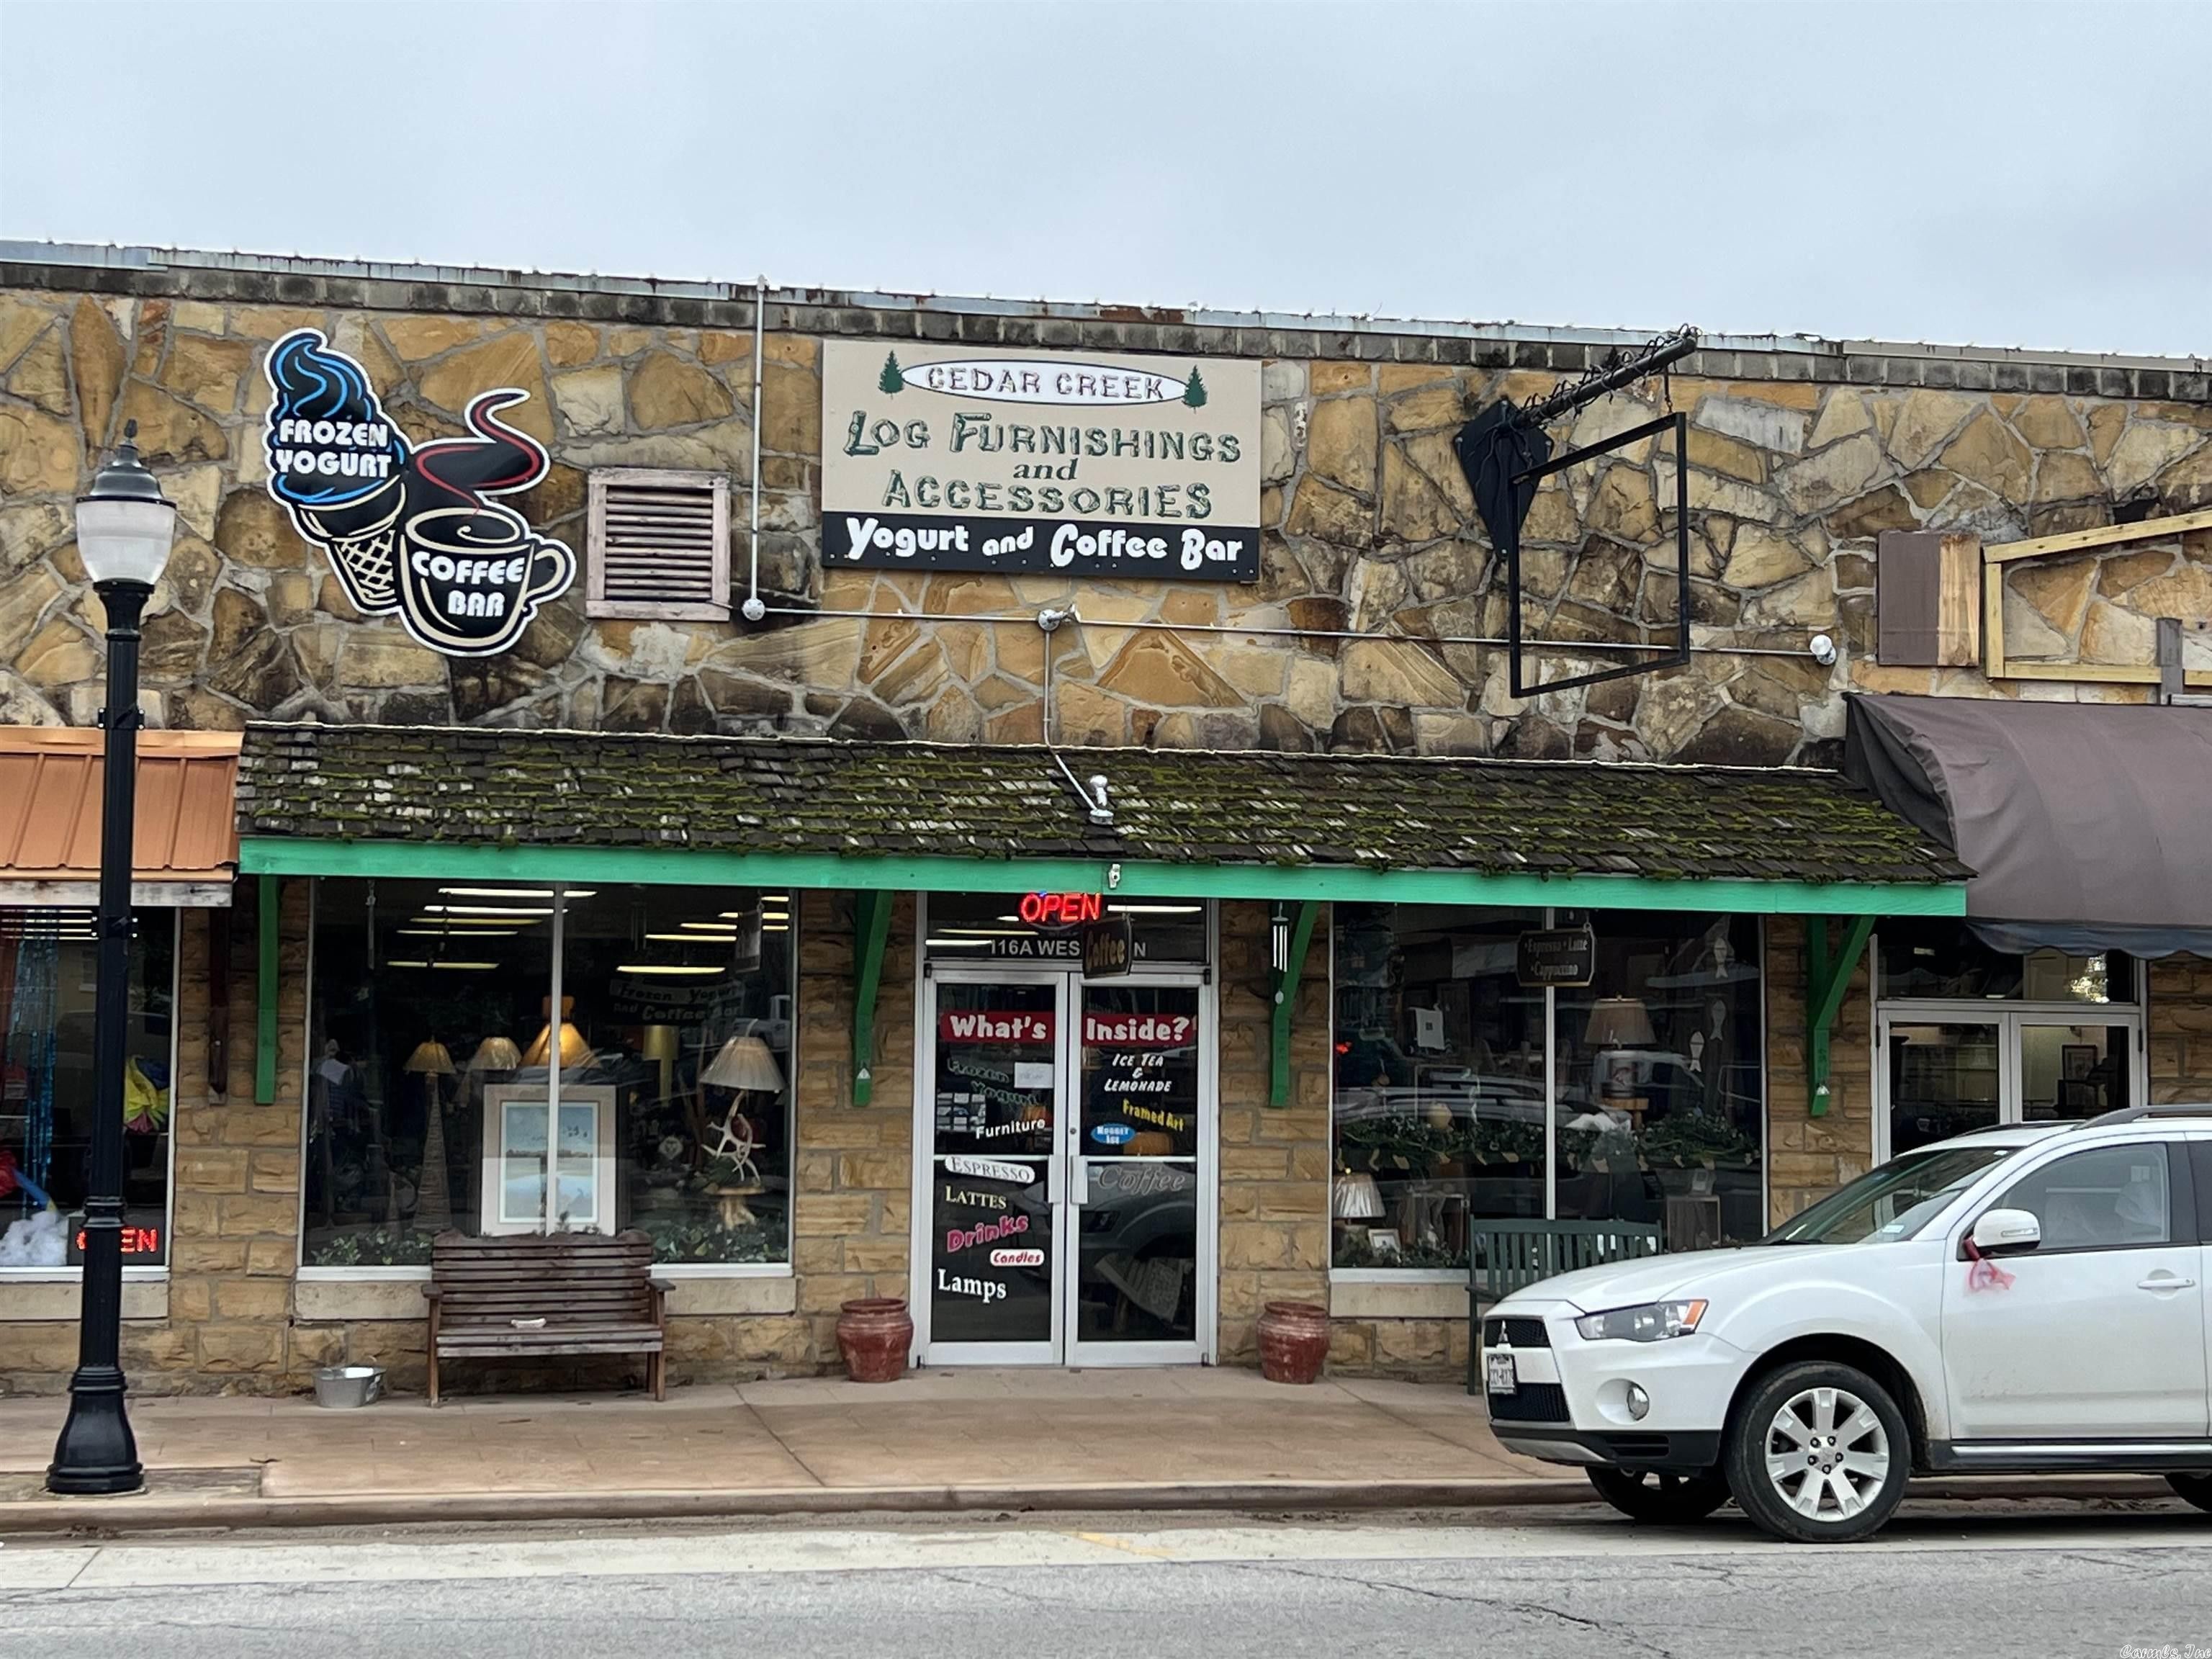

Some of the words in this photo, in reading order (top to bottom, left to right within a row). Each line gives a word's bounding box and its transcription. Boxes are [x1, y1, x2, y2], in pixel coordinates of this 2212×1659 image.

[927, 366, 1041, 395] CEDAR
[1056, 372, 1165, 402] CREEK
[278, 418, 389, 449] FROZEN
[842, 410, 931, 458] LOG
[949, 412, 1242, 463] FURNISHINGS
[275, 449, 392, 479] YOGURT
[1012, 458, 1079, 481] and
[881, 469, 1213, 520] ACCESSORIES
[846, 517, 970, 560] Yogurt
[981, 527, 1035, 557] and
[1050, 523, 1168, 567] Coffee
[1181, 528, 1244, 570] Bar
[411, 551, 526, 585] COFFEE
[447, 592, 505, 617] BAR
[1020, 893, 1101, 922] OPEN
[991, 940, 1033, 956] 116A
[1037, 941, 1081, 956] WES
[1085, 931, 1125, 972] Coffee
[950, 1015, 1047, 1040] What's
[1086, 1016, 1190, 1041] Inside?
[1112, 1053, 1134, 1067] ICE
[1141, 1055, 1164, 1067] TEA
[1104, 1080, 1172, 1092] LEMONADE
[976, 1118, 1046, 1139] Furniture
[1123, 1098, 1165, 1126] Framed
[1166, 1112, 1184, 1131] Art
[951, 1157, 1030, 1182] ESPRESSO
[1098, 1165, 1186, 1195] Coffee
[945, 1185, 1007, 1209] LATTES
[946, 1215, 1029, 1252] Drinks
[993, 1251, 1041, 1264] Candles
[938, 1269, 1007, 1303] Lamps
